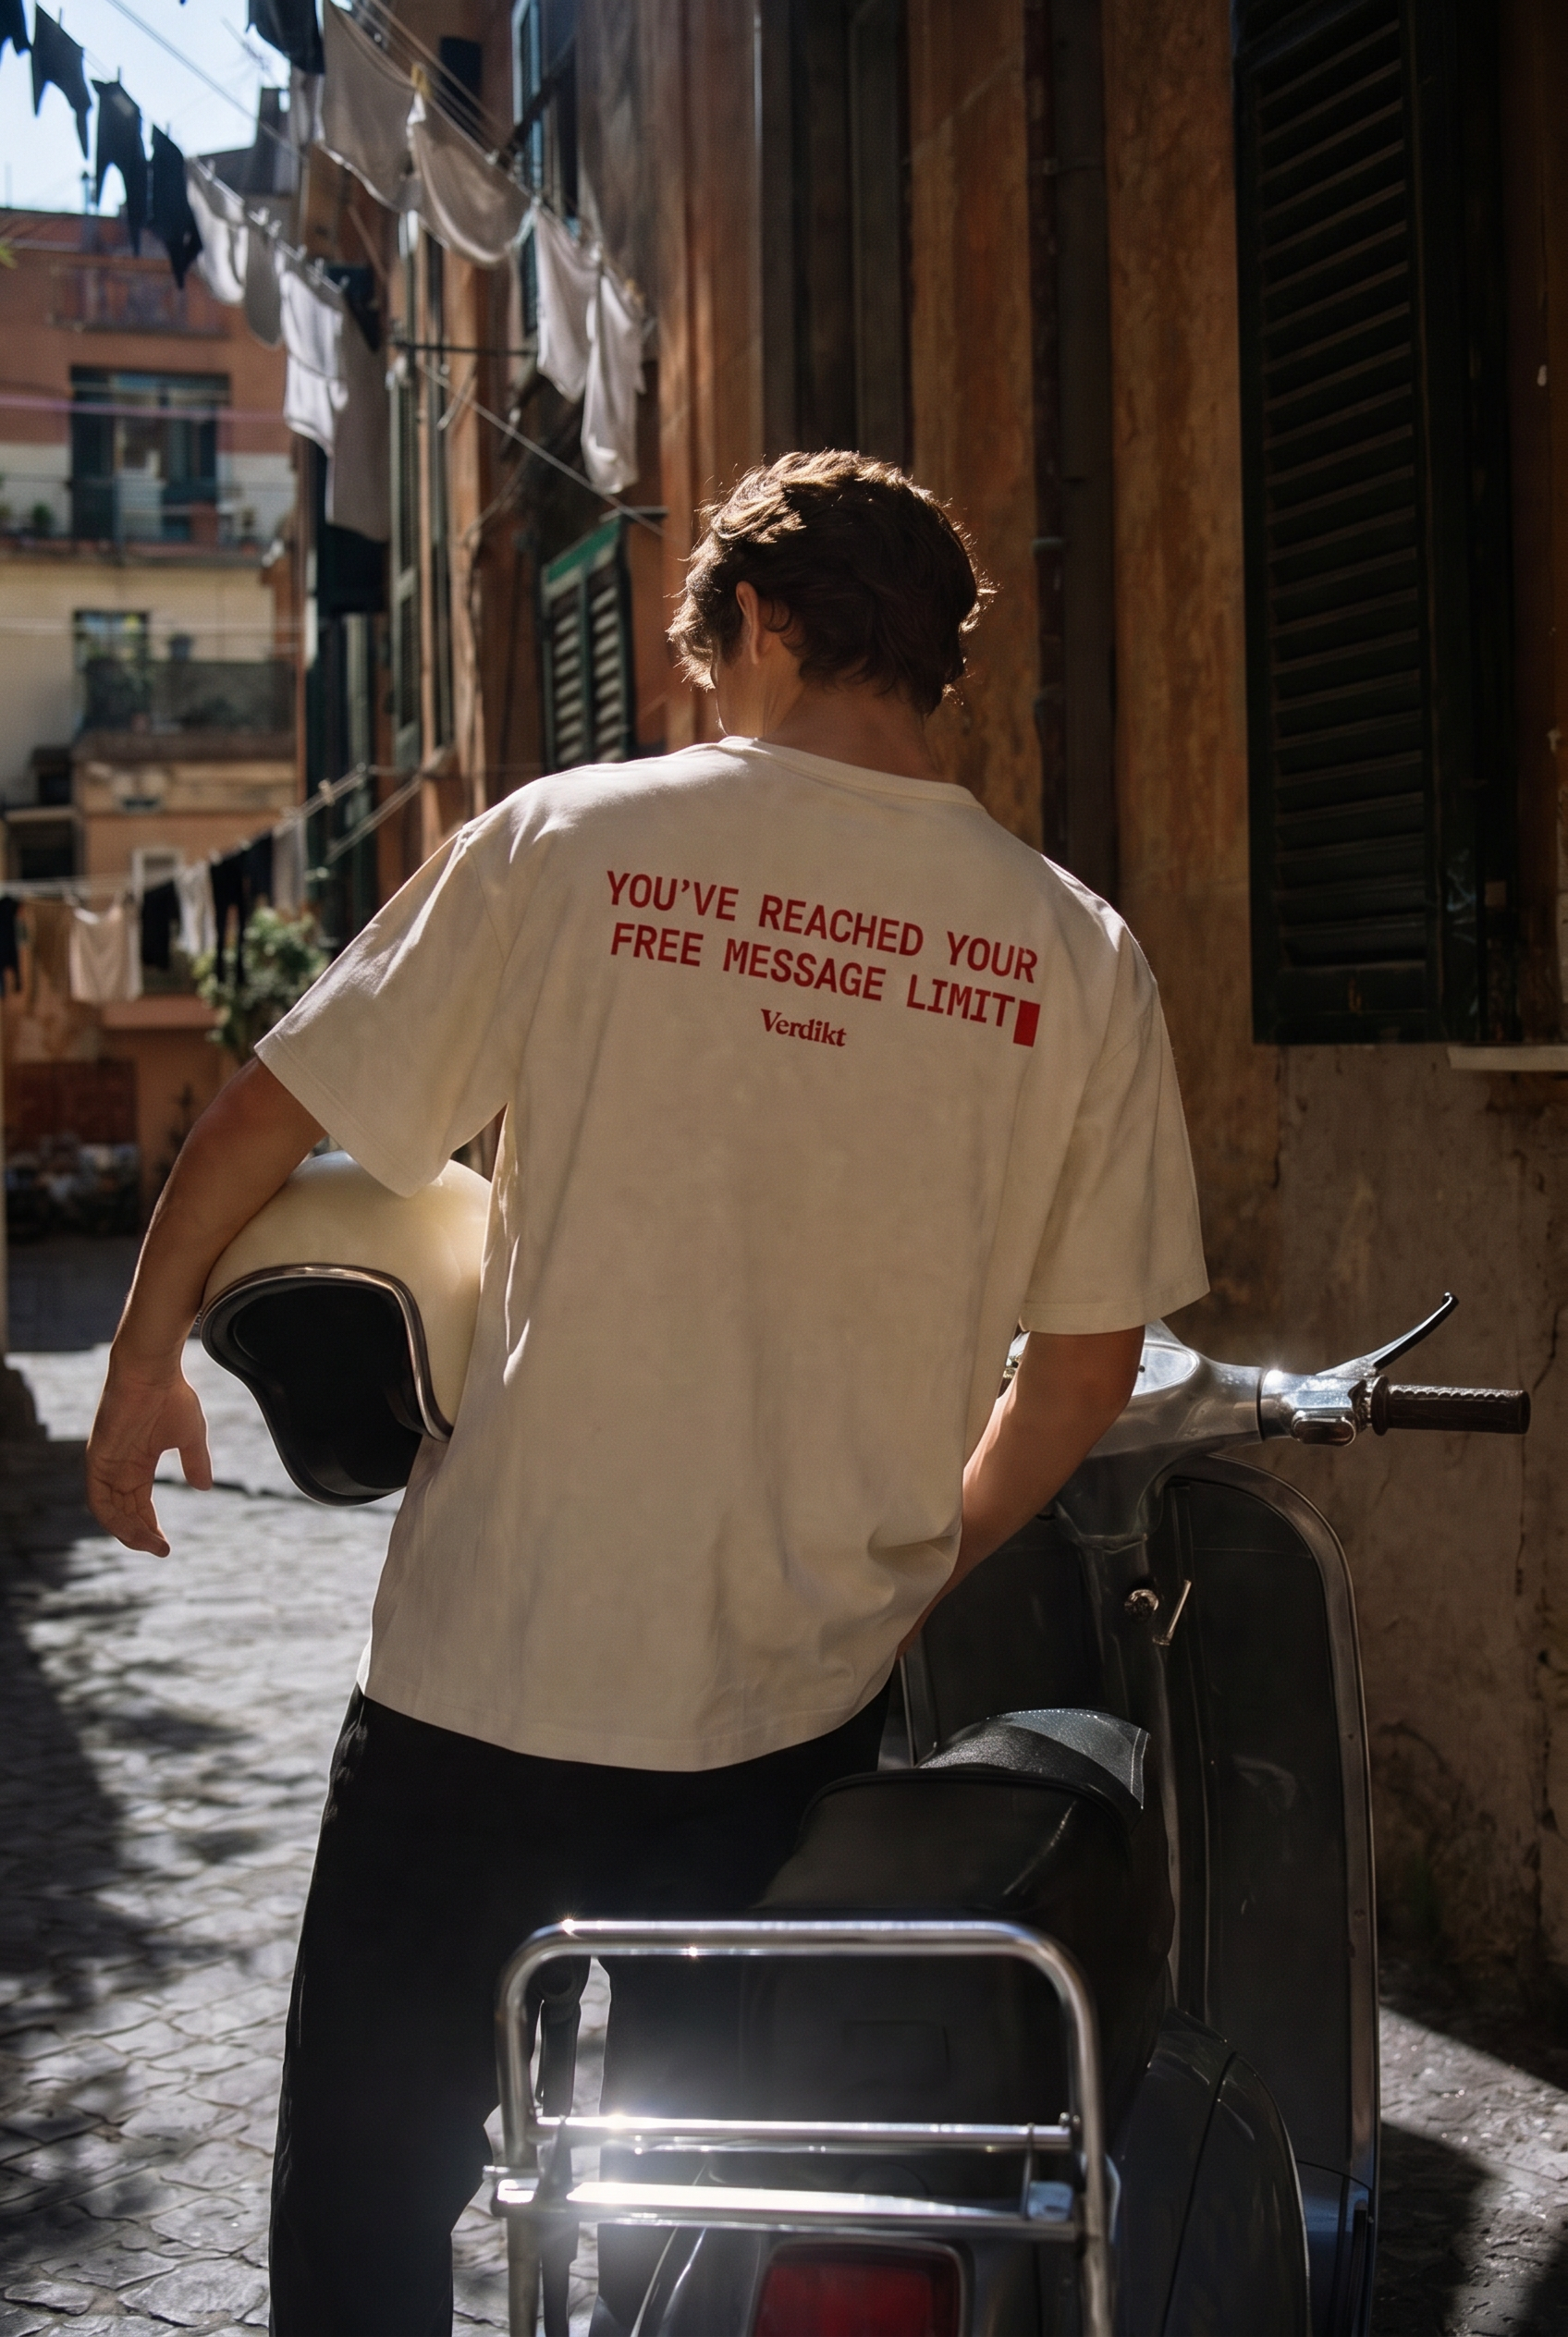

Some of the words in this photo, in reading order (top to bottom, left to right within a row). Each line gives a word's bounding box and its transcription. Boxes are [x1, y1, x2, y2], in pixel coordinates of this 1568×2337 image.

[607, 871, 739, 922] YOU'VE
[758, 894, 925, 957] REACHED
[947, 932, 1038, 983] YOUR
[610, 922, 704, 967] FREE
[723, 937, 886, 1001] MESSAGE
[906, 974, 1015, 1028] LIMIT
[760, 1009, 846, 1047] Verdikt
